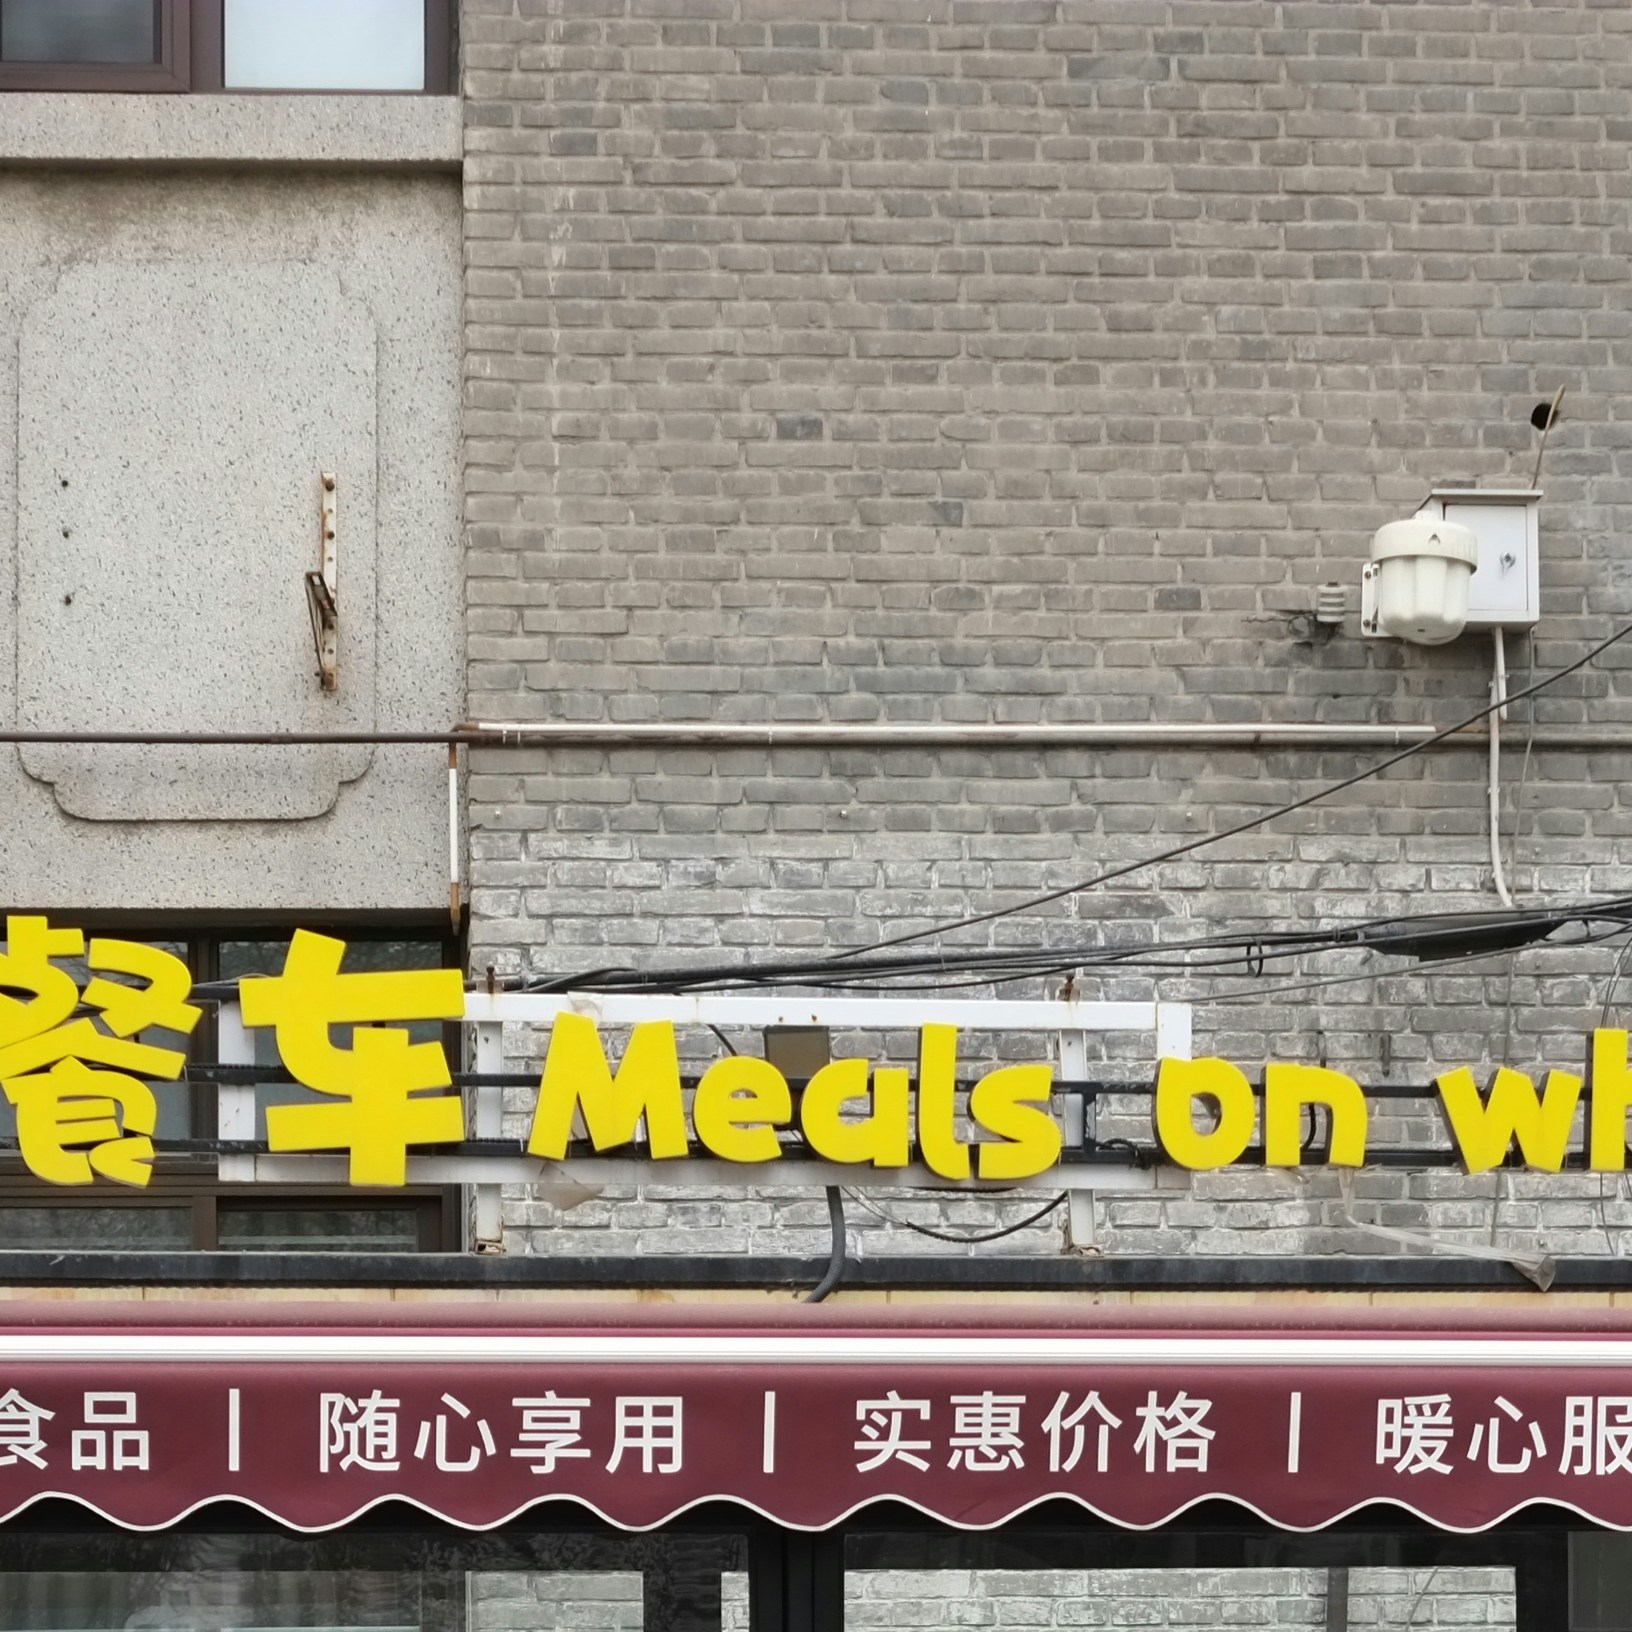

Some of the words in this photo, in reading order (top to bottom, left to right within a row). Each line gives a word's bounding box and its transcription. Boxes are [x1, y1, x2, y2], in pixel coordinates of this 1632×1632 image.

[527, 1010, 1063, 1181] Meals
[1156, 1056, 1369, 1170] on
[318, 1388, 684, 1476] 随心享用
[853, 1389, 1217, 1474] 实惠价格
